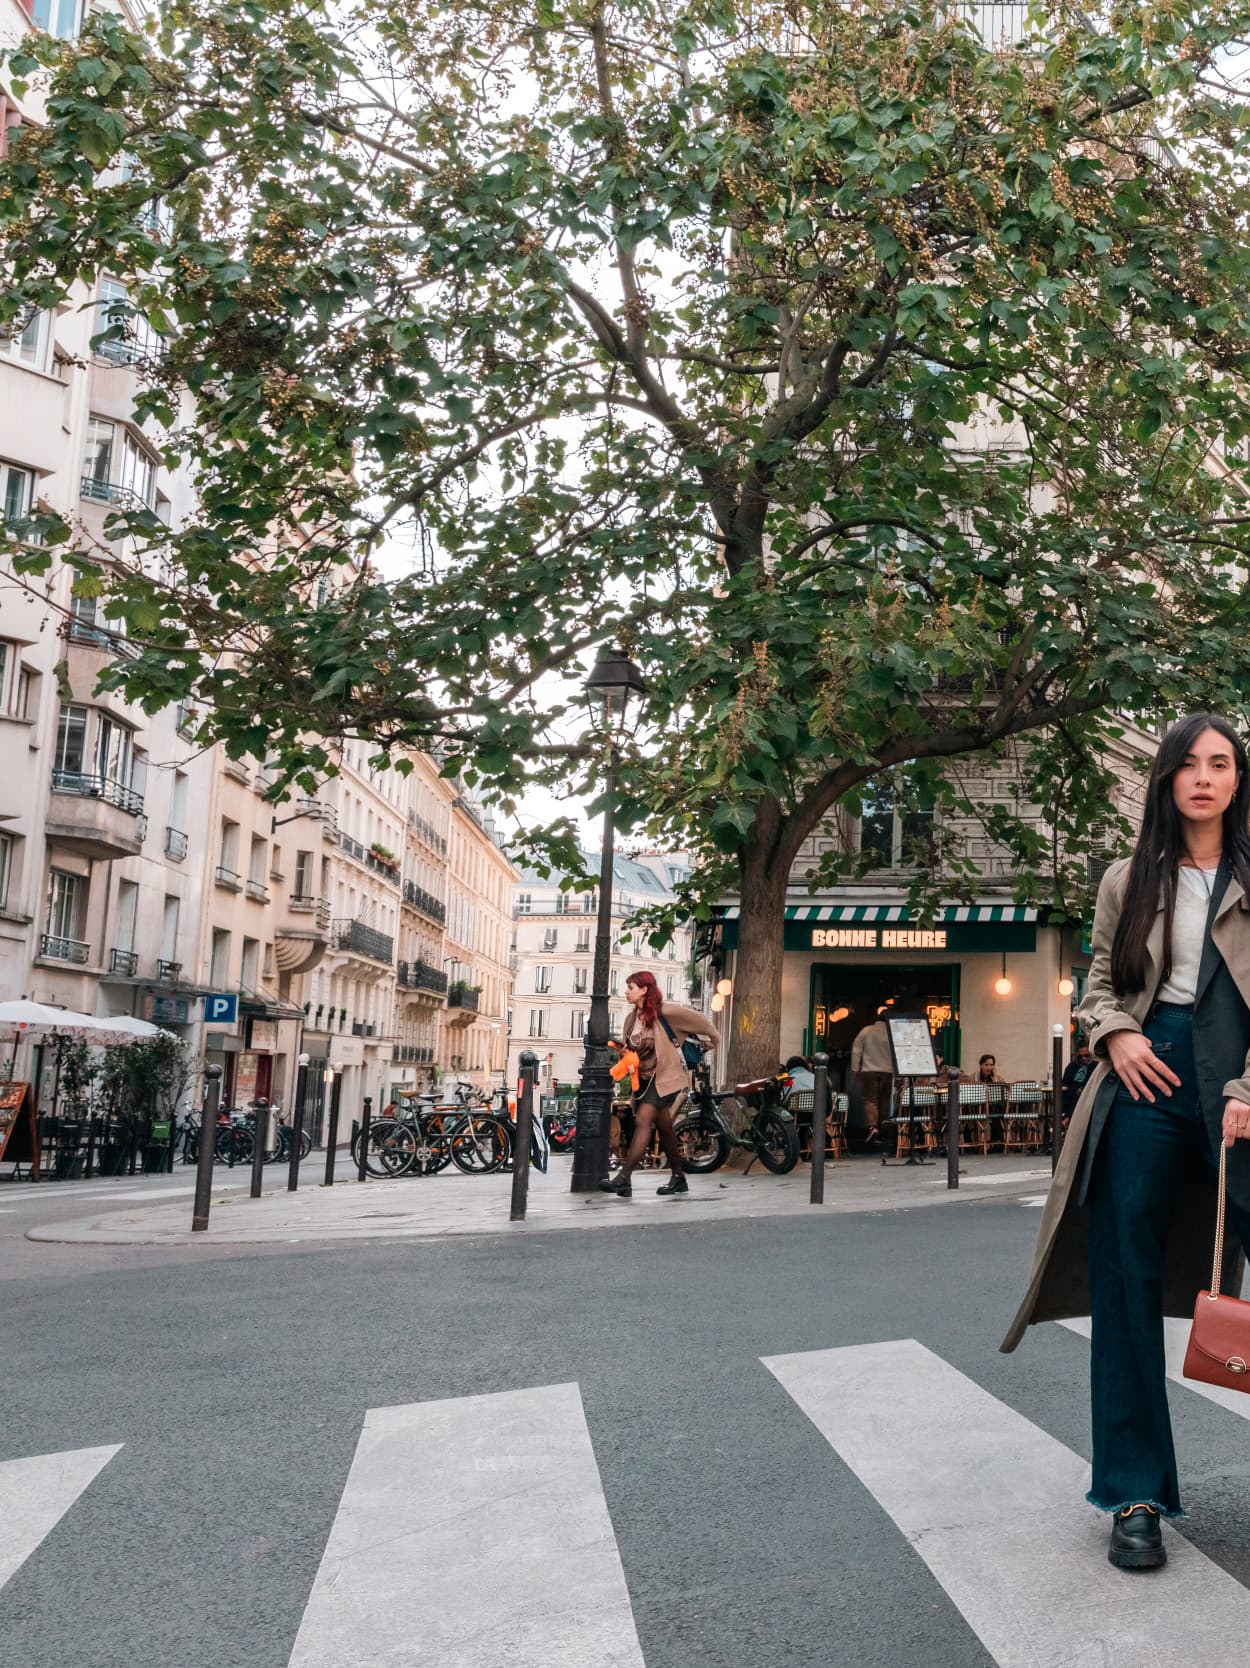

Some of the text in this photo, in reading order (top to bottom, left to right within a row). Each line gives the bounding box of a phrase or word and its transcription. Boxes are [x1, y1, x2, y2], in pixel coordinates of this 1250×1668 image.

[812, 929, 947, 948] BONNE HEURE
[213, 998, 229, 1018] P
